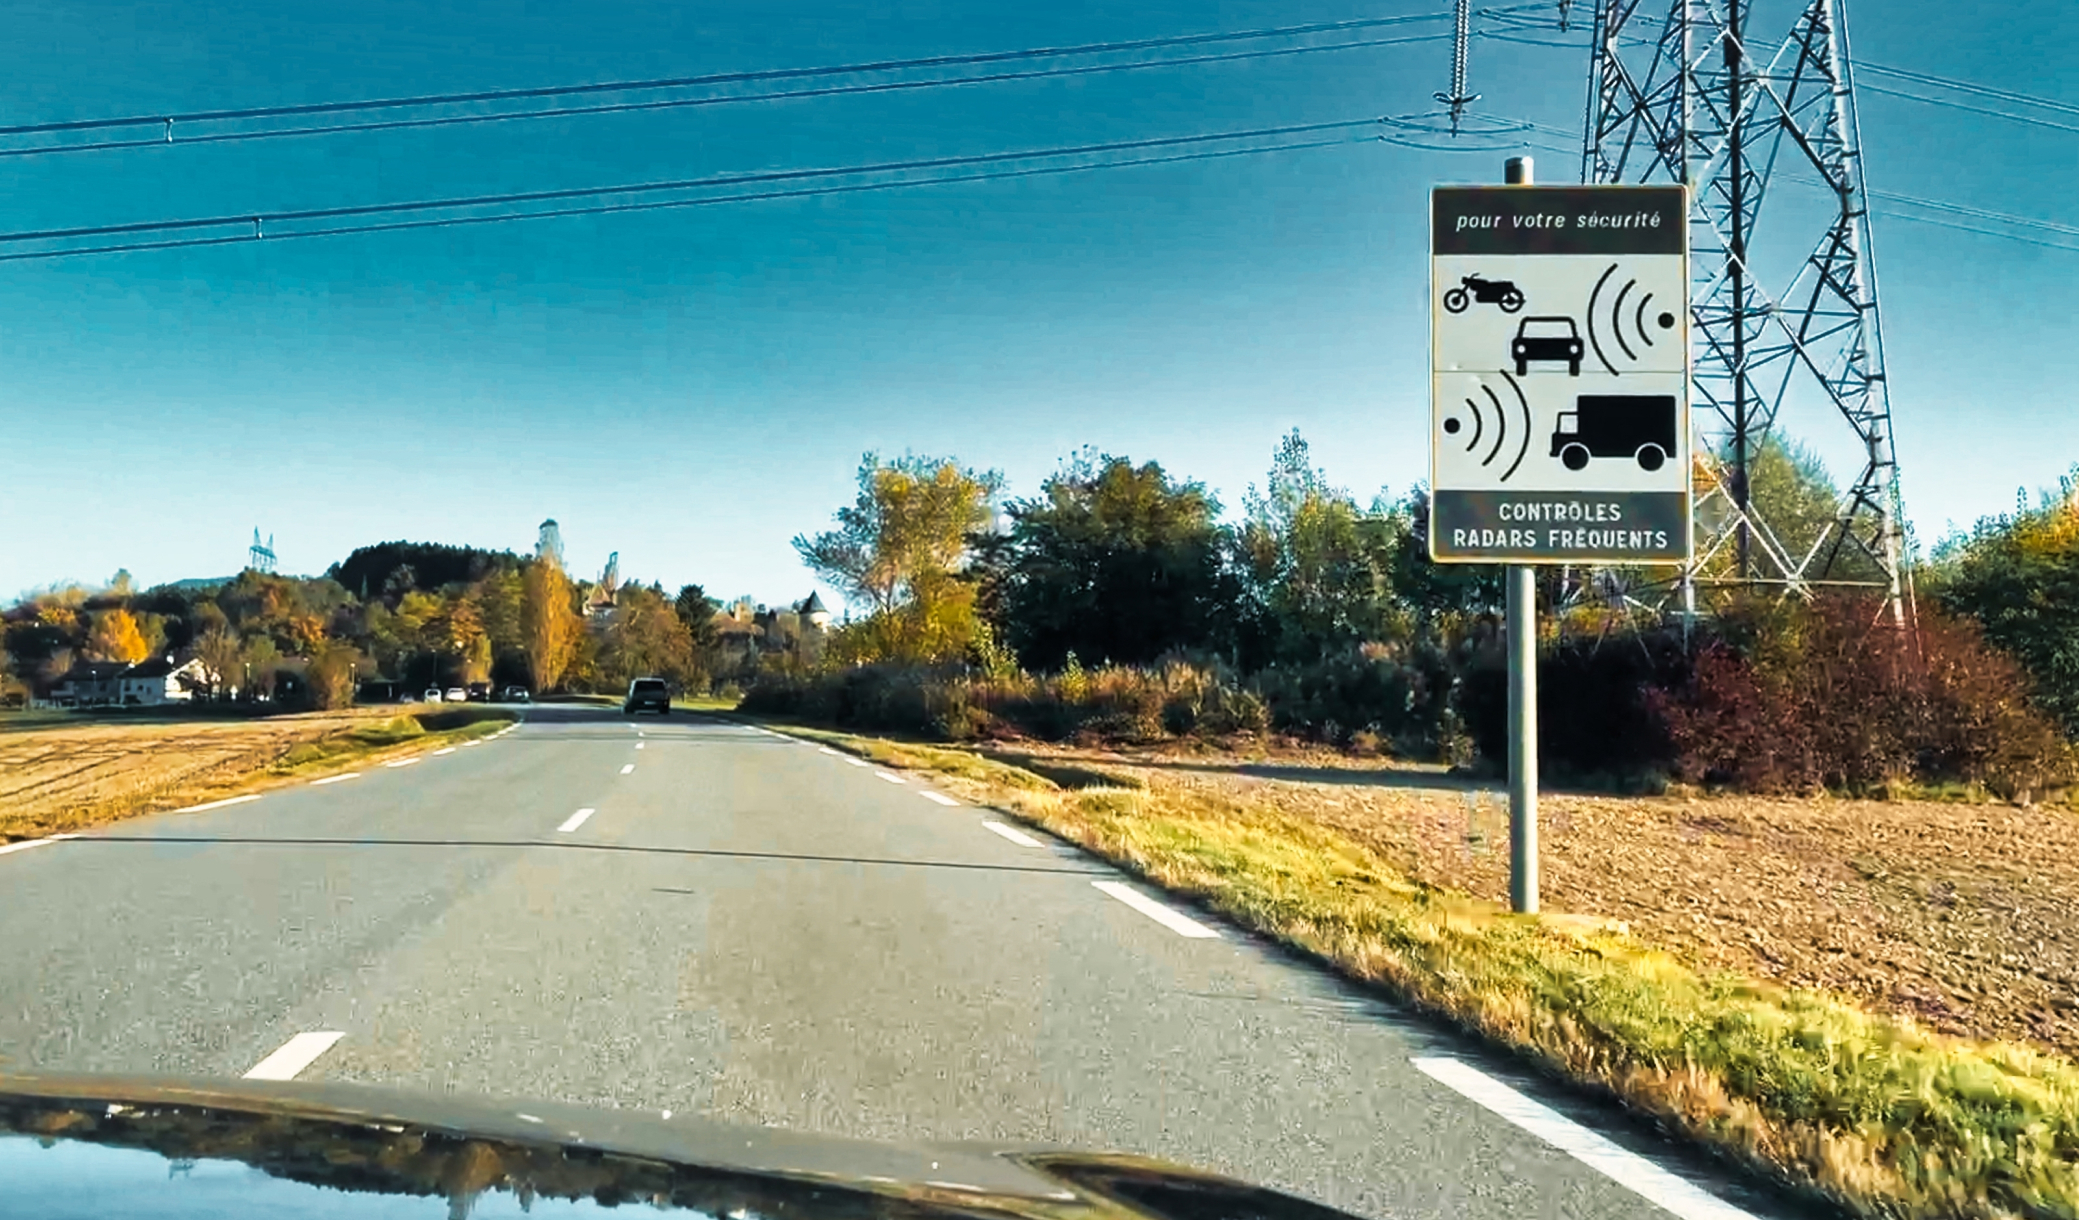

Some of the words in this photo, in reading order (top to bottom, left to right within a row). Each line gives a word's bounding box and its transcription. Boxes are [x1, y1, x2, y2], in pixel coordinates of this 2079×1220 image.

[1456, 214, 1502, 232] pour
[1513, 213, 1566, 228] votre
[1577, 210, 1662, 228] sécurité
[1499, 501, 1622, 522] CONTRÔLES
[1454, 528, 1537, 548] RADARS
[1549, 528, 1668, 549] FRÉQUENTS
